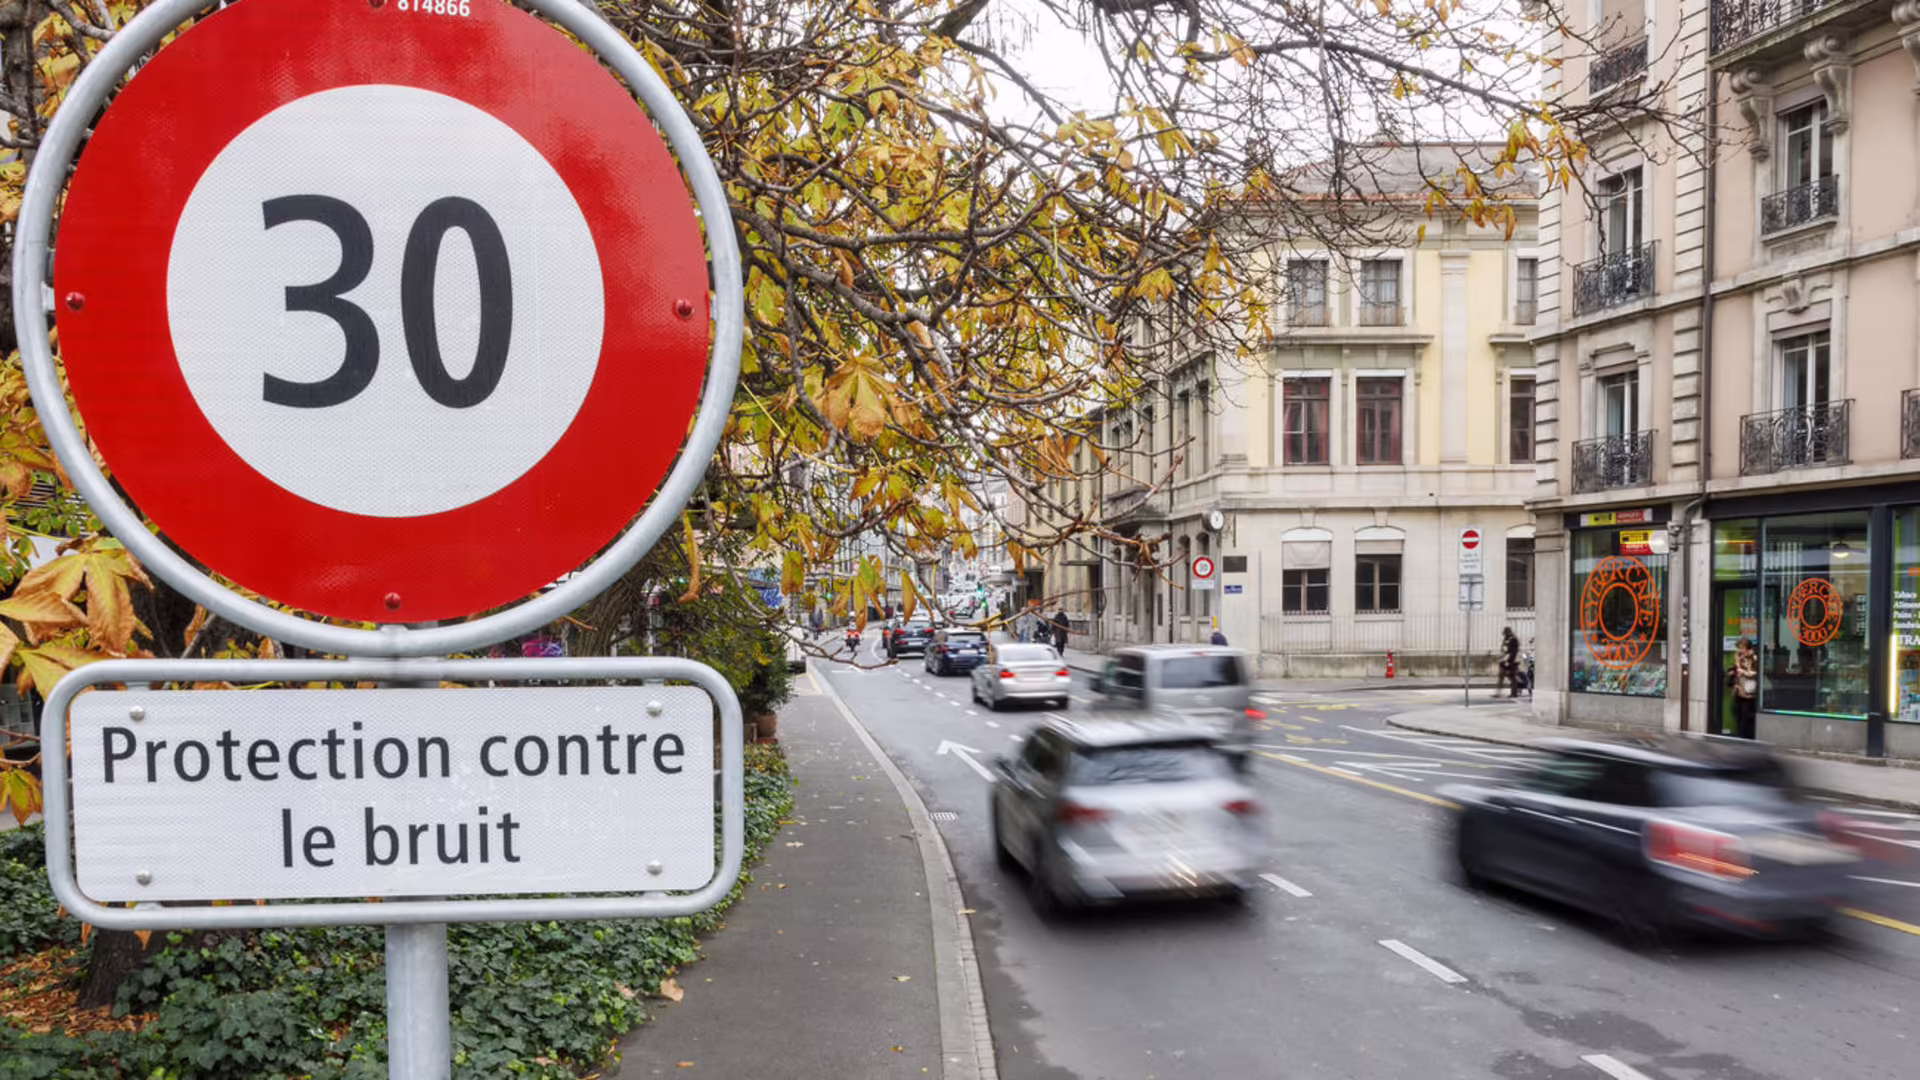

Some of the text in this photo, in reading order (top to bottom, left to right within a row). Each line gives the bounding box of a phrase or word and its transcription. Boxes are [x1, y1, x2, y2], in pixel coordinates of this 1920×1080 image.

[261, 193, 514, 409] 30
[101, 721, 686, 784] Protection contre
[281, 806, 522, 869] le bruit
